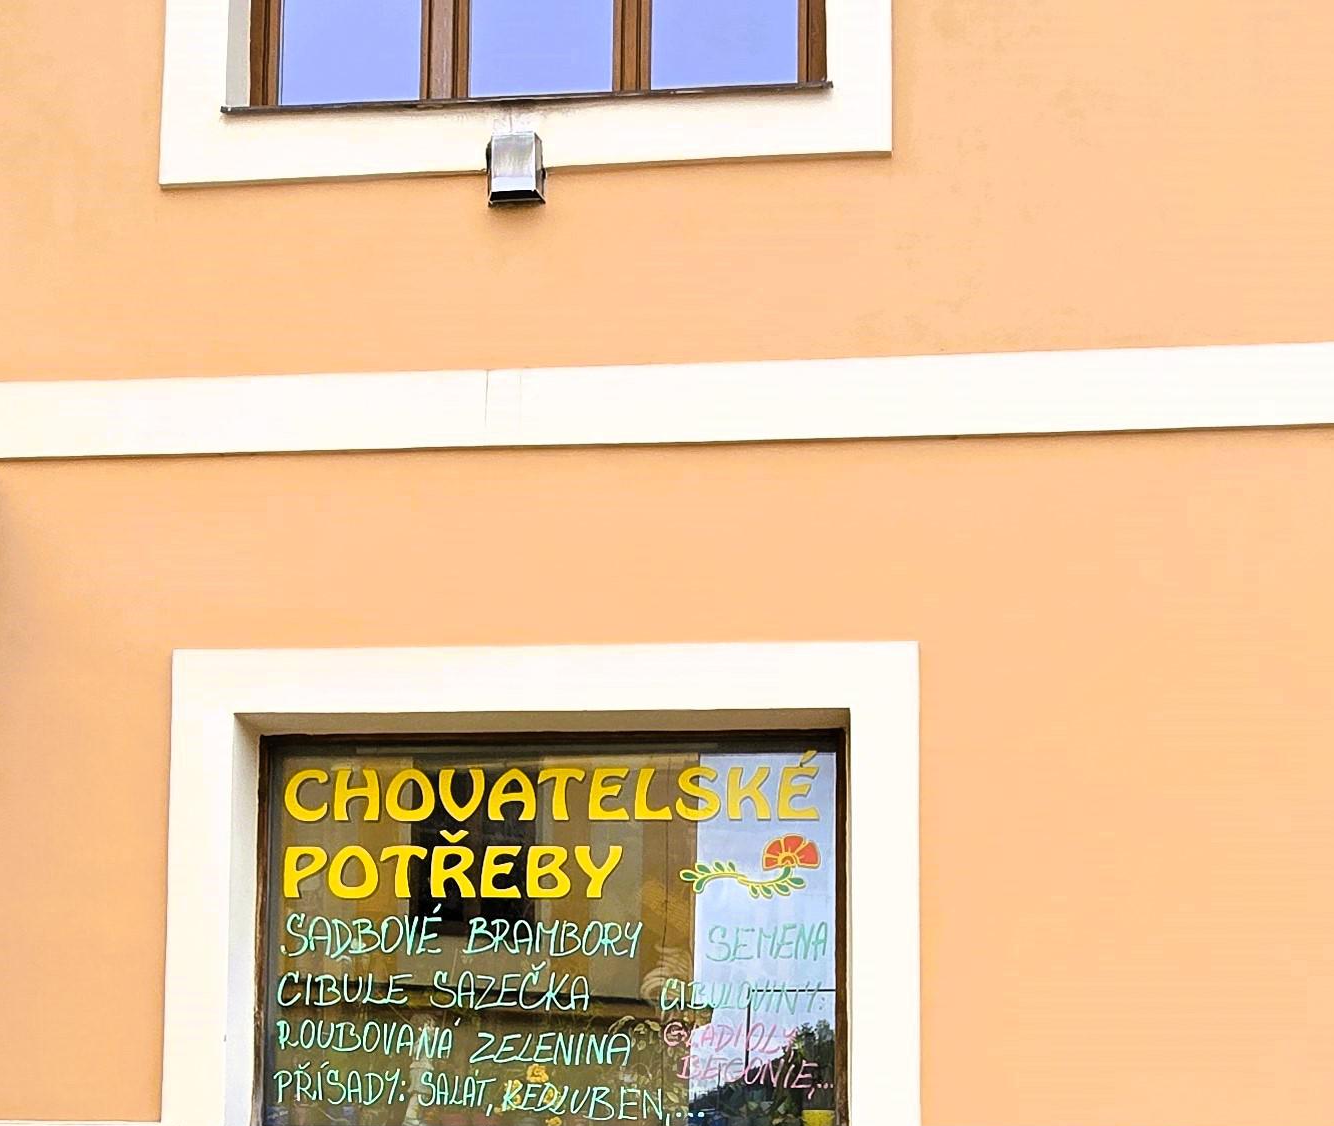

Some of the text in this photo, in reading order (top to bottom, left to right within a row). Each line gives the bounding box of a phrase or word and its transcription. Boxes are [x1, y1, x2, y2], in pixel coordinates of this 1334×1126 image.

[284, 750, 820, 823] CHOVATELSKÉ
[283, 829, 623, 899] POTŘEBY
[280, 903, 643, 958] SADBOVÉ BRAMBORY
[706, 921, 828, 963] SEMENA
[277, 960, 590, 1011] CIBULE SAZEČKA
[276, 1017, 632, 1067] ROUBOVANÁ ZELENINA
[273, 1061, 406, 1106] PŘÍSADY:
[418, 1069, 497, 1117] SALÁT,
